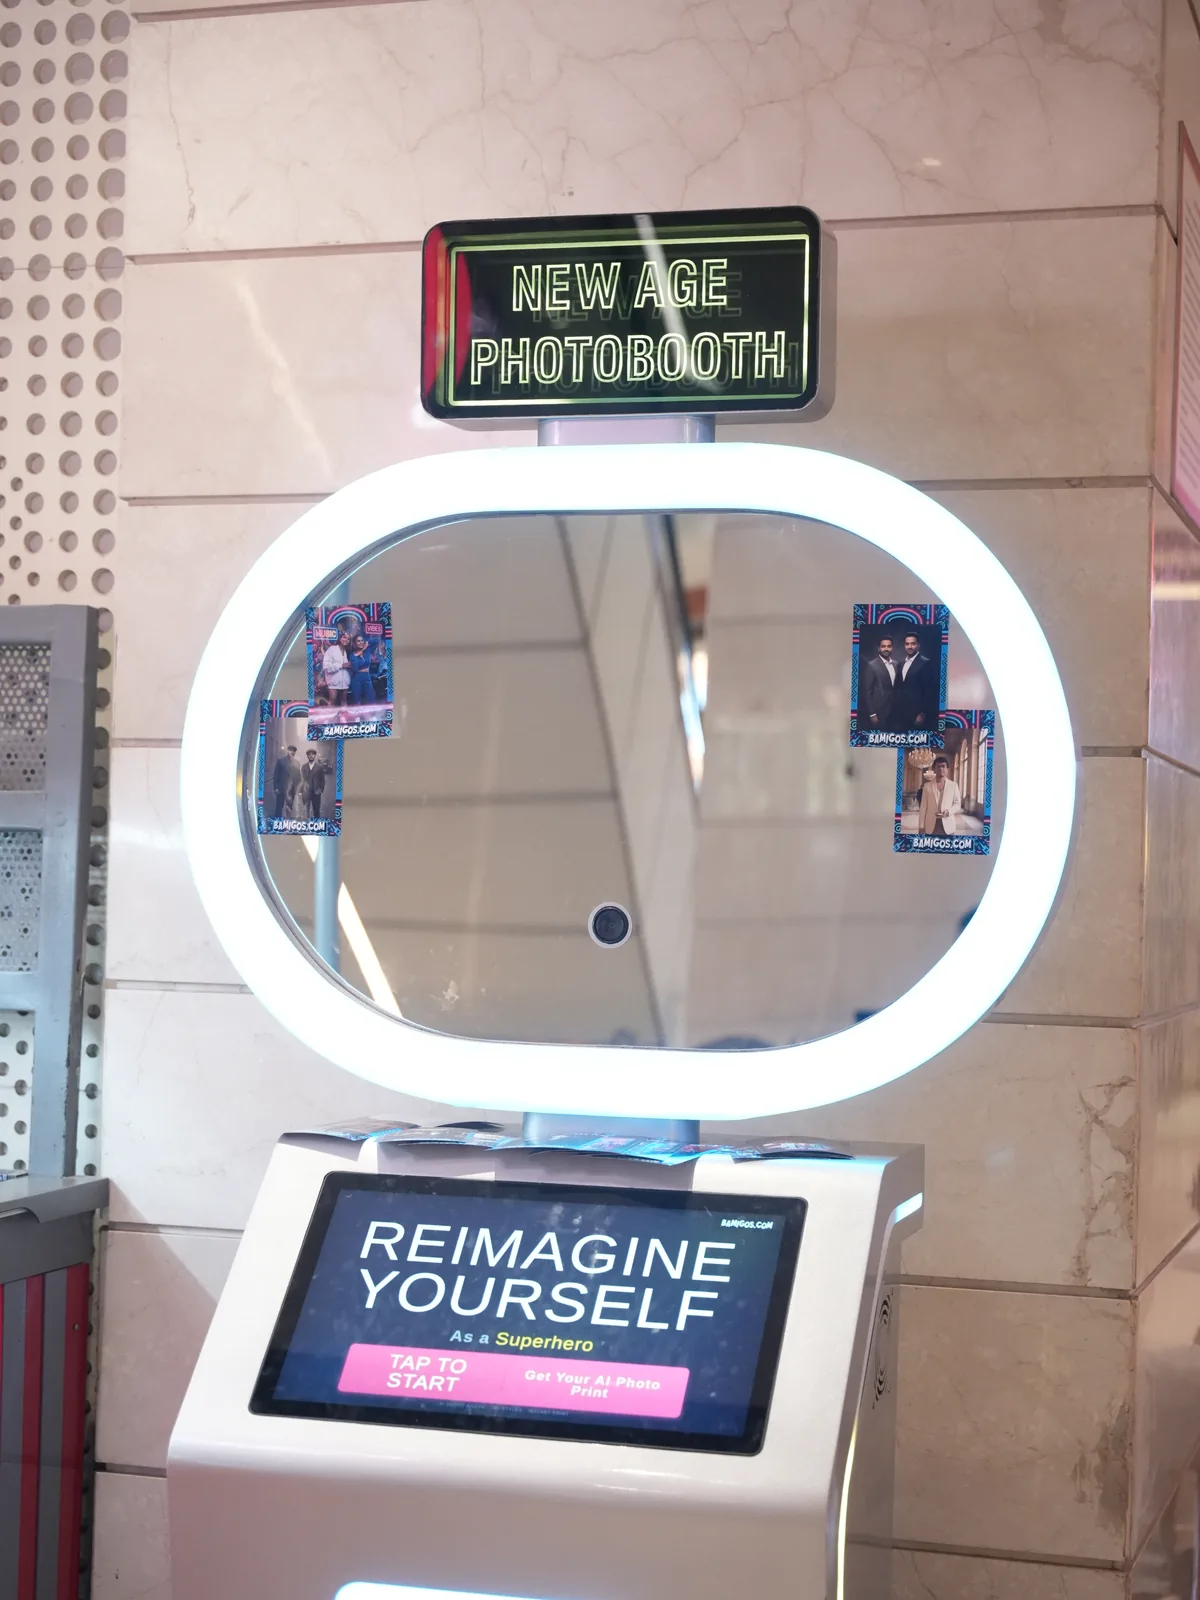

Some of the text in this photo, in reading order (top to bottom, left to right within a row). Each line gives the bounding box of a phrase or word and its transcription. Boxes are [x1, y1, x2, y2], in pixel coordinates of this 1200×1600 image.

[512, 258, 728, 312] NEW AGE
[470, 330, 786, 386] PHOTOBOOTH
[315, 629, 337, 639] MUSIC
[324, 723, 376, 736] BAMIGOS.COM
[868, 732, 928, 745] BAMIGOS.COM
[273, 820, 326, 832] BAMIGOS.COM
[912, 837, 973, 850] BAMIGOS.COM
[720, 1219, 774, 1229] BAMIGOS.COM
[359, 1220, 737, 1283] REIMAGINE
[359, 1268, 719, 1332] YOURSELF
[450, 1330, 594, 1352] As a Superhero
[390, 1353, 467, 1374] TAP TO
[386, 1372, 459, 1393] START
[524, 1369, 661, 1391] Get Your AI Photo
[570, 1385, 609, 1399] Print
